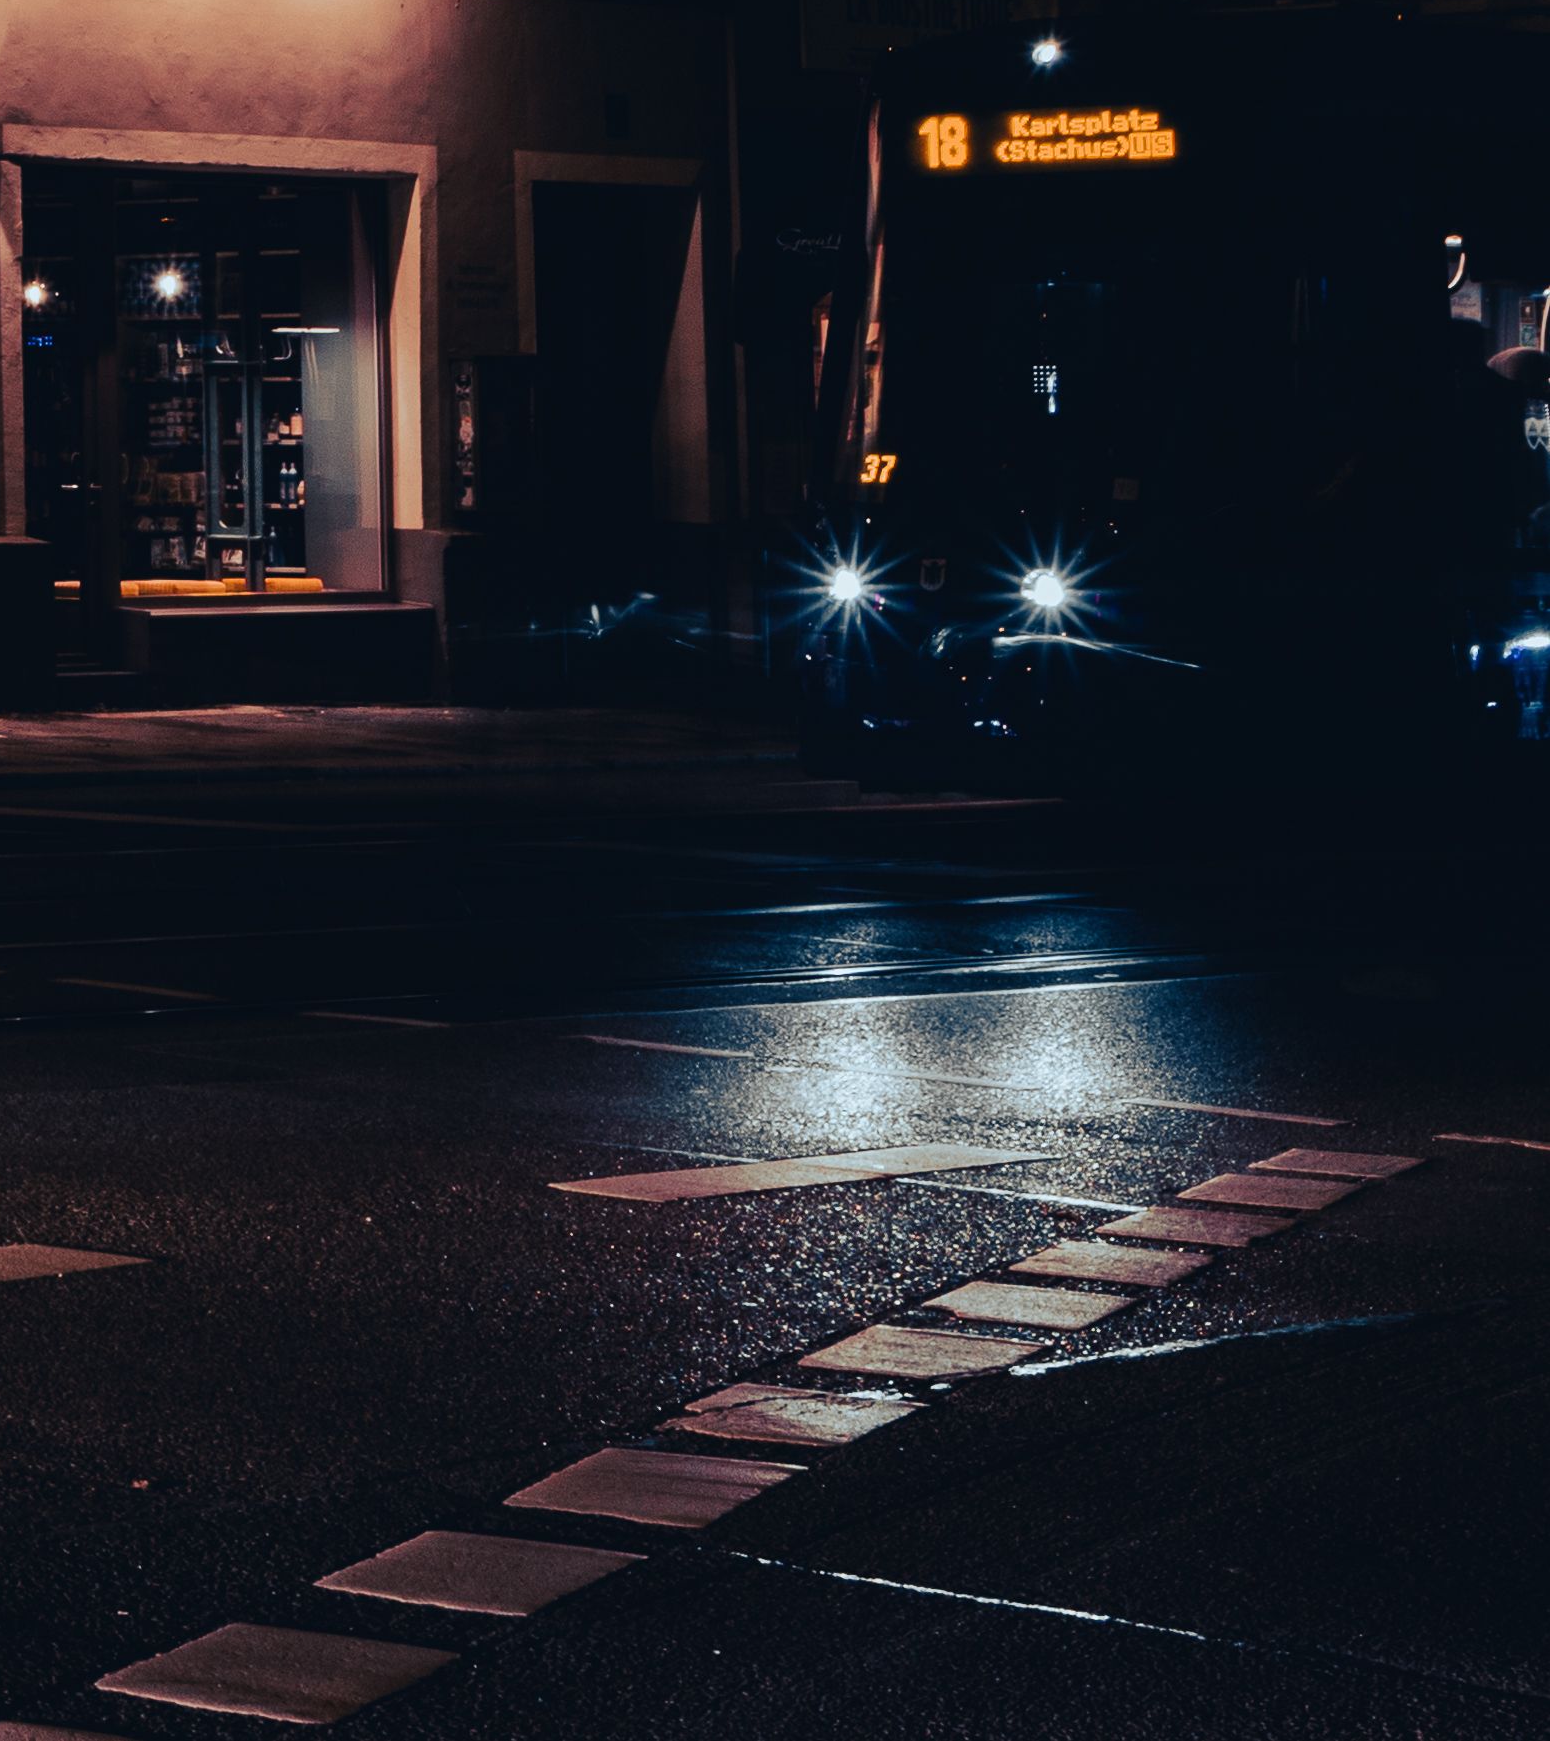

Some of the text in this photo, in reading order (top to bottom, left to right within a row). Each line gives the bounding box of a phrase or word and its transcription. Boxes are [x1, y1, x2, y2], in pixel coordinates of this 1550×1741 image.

[918, 109, 1160, 168] 18 Karlsplatz
[860, 453, 897, 483] 37
